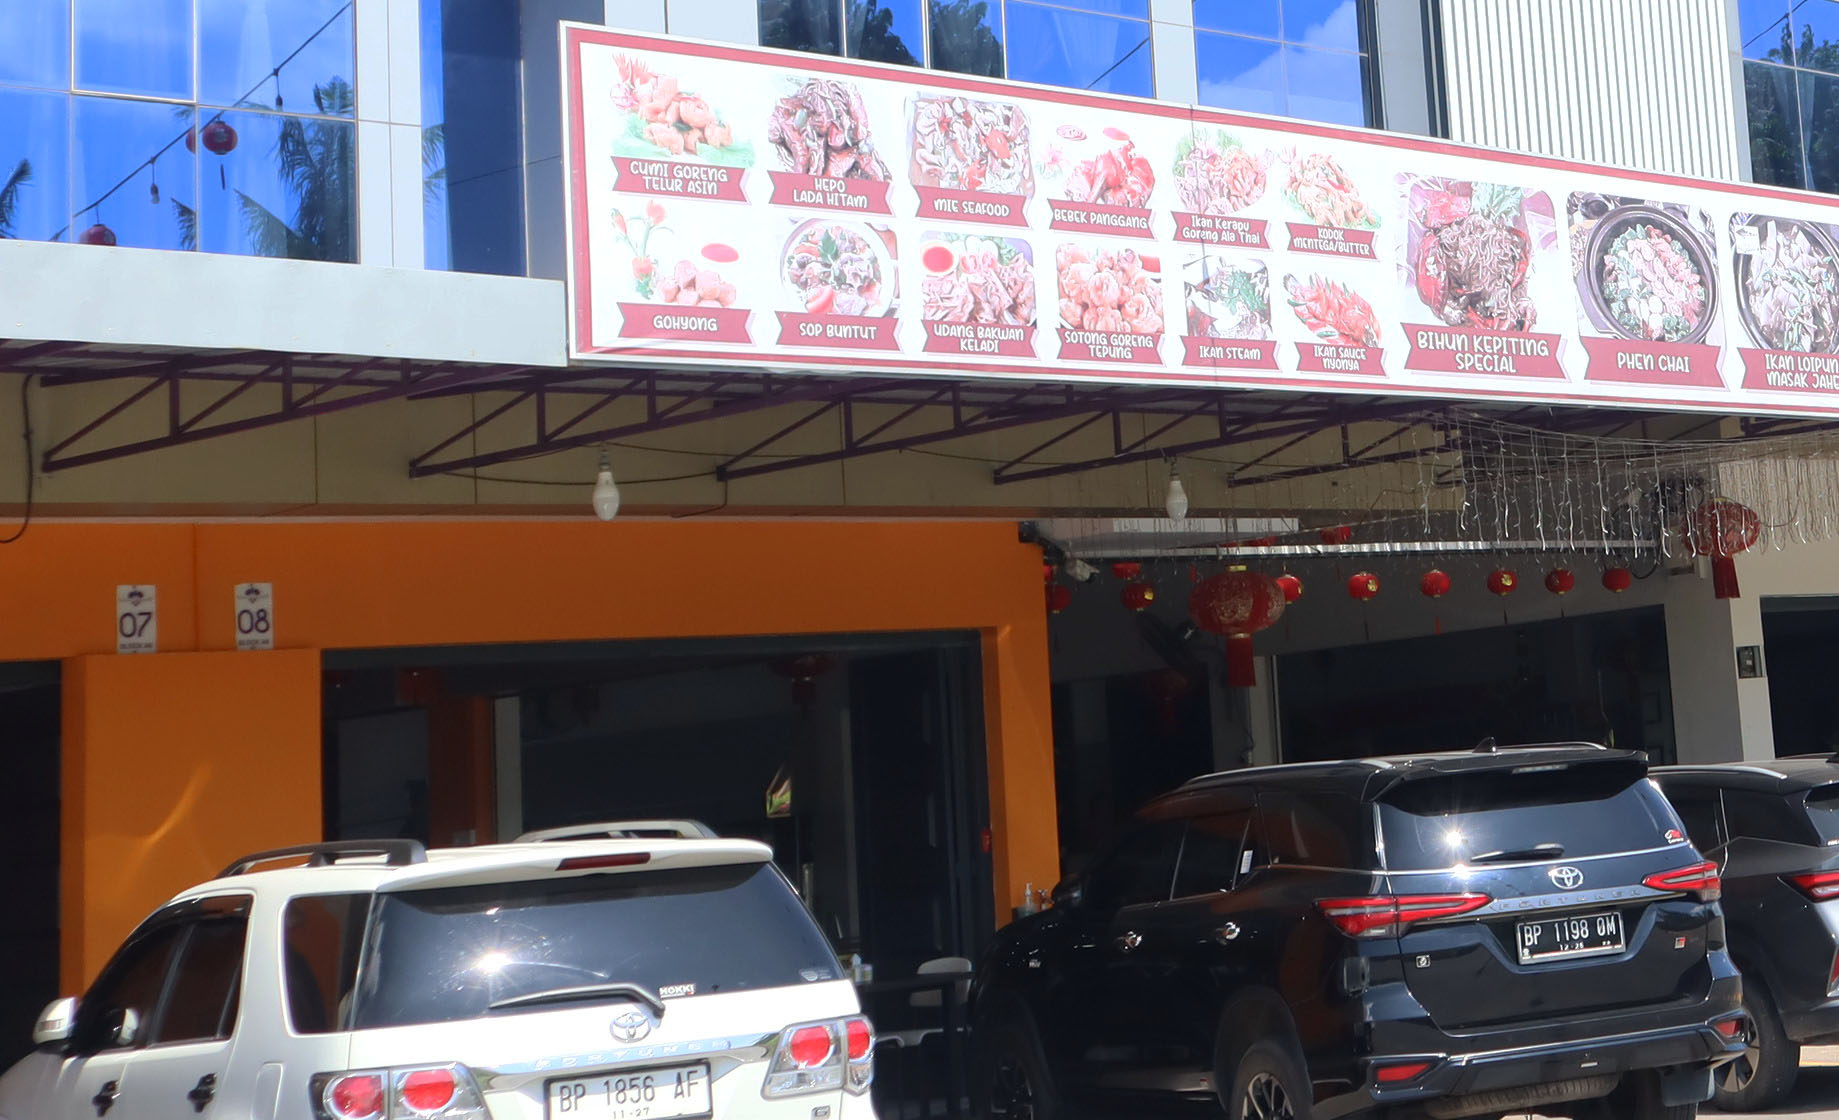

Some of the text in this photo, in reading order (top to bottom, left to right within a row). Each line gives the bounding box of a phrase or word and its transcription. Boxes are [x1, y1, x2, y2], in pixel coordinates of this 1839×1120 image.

[630, 162, 728, 182] CUMI GORENG
[643, 176, 718, 195] TELUR ASIN
[814, 178, 846, 192] HEPO
[793, 189, 868, 209] LADA HITAM
[934, 199, 1010, 217] MIE SEAFOOD
[1054, 209, 1148, 230] BEBEK PANGGANG
[1317, 227, 1345, 241] KODOK
[653, 315, 718, 332] GOHYONG
[800, 322, 877, 341] SOP BUNTUT
[933, 324, 1024, 341] UDANG BAKWAN
[960, 337, 999, 353] KELADI
[1065, 331, 1154, 349] SOTONG GORENG
[1417, 331, 1549, 358] BIHUN KEPITING
[1088, 343, 1132, 360] TEPUNG
[1199, 346, 1261, 361] IKAN STEAM
[1314, 345, 1366, 360] IKAN SAUCE
[1456, 353, 1517, 374] SPECIAL
[1617, 352, 1690, 374] PHEN CHAI
[1765, 353, 1839, 374] IKAN LOIPUN
[1766, 371, 1808, 388] MASAK
[118, 612, 152, 638] 07
[237, 609, 270, 634] 08
[1523, 924, 1542, 946] BP
[1554, 920, 1590, 944] 1198
[559, 1070, 699, 1113] BP 1856 AF
